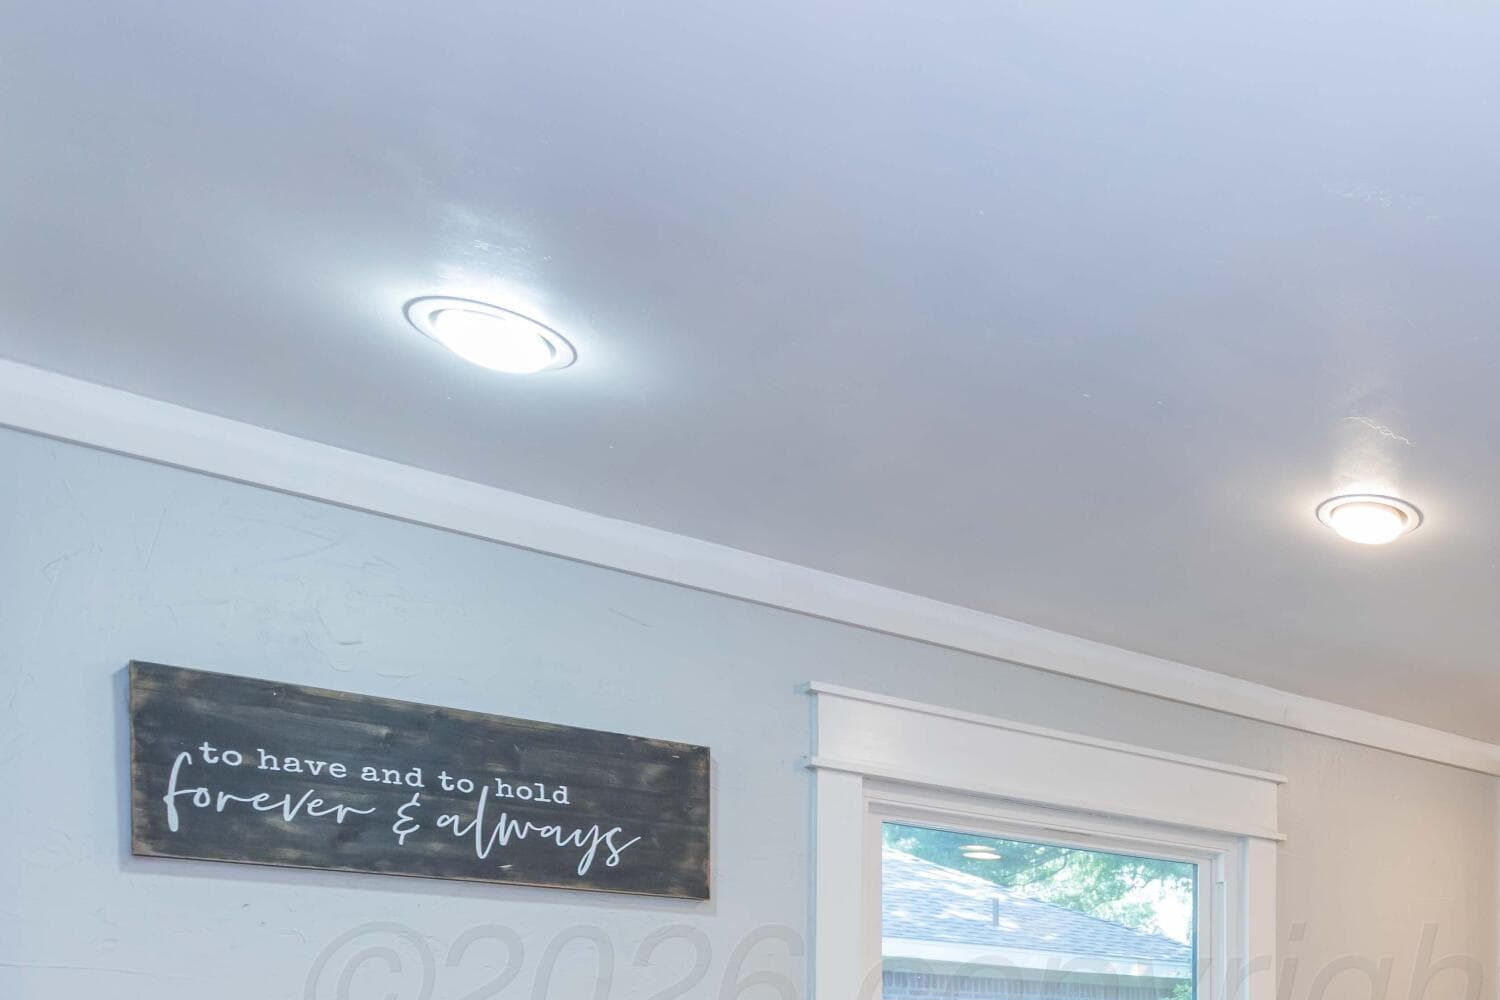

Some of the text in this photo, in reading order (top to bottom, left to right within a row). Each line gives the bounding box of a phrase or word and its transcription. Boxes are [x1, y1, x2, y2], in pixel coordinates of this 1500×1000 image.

[163, 751, 642, 876] forever & always
[199, 741, 570, 805] to have and to hold
